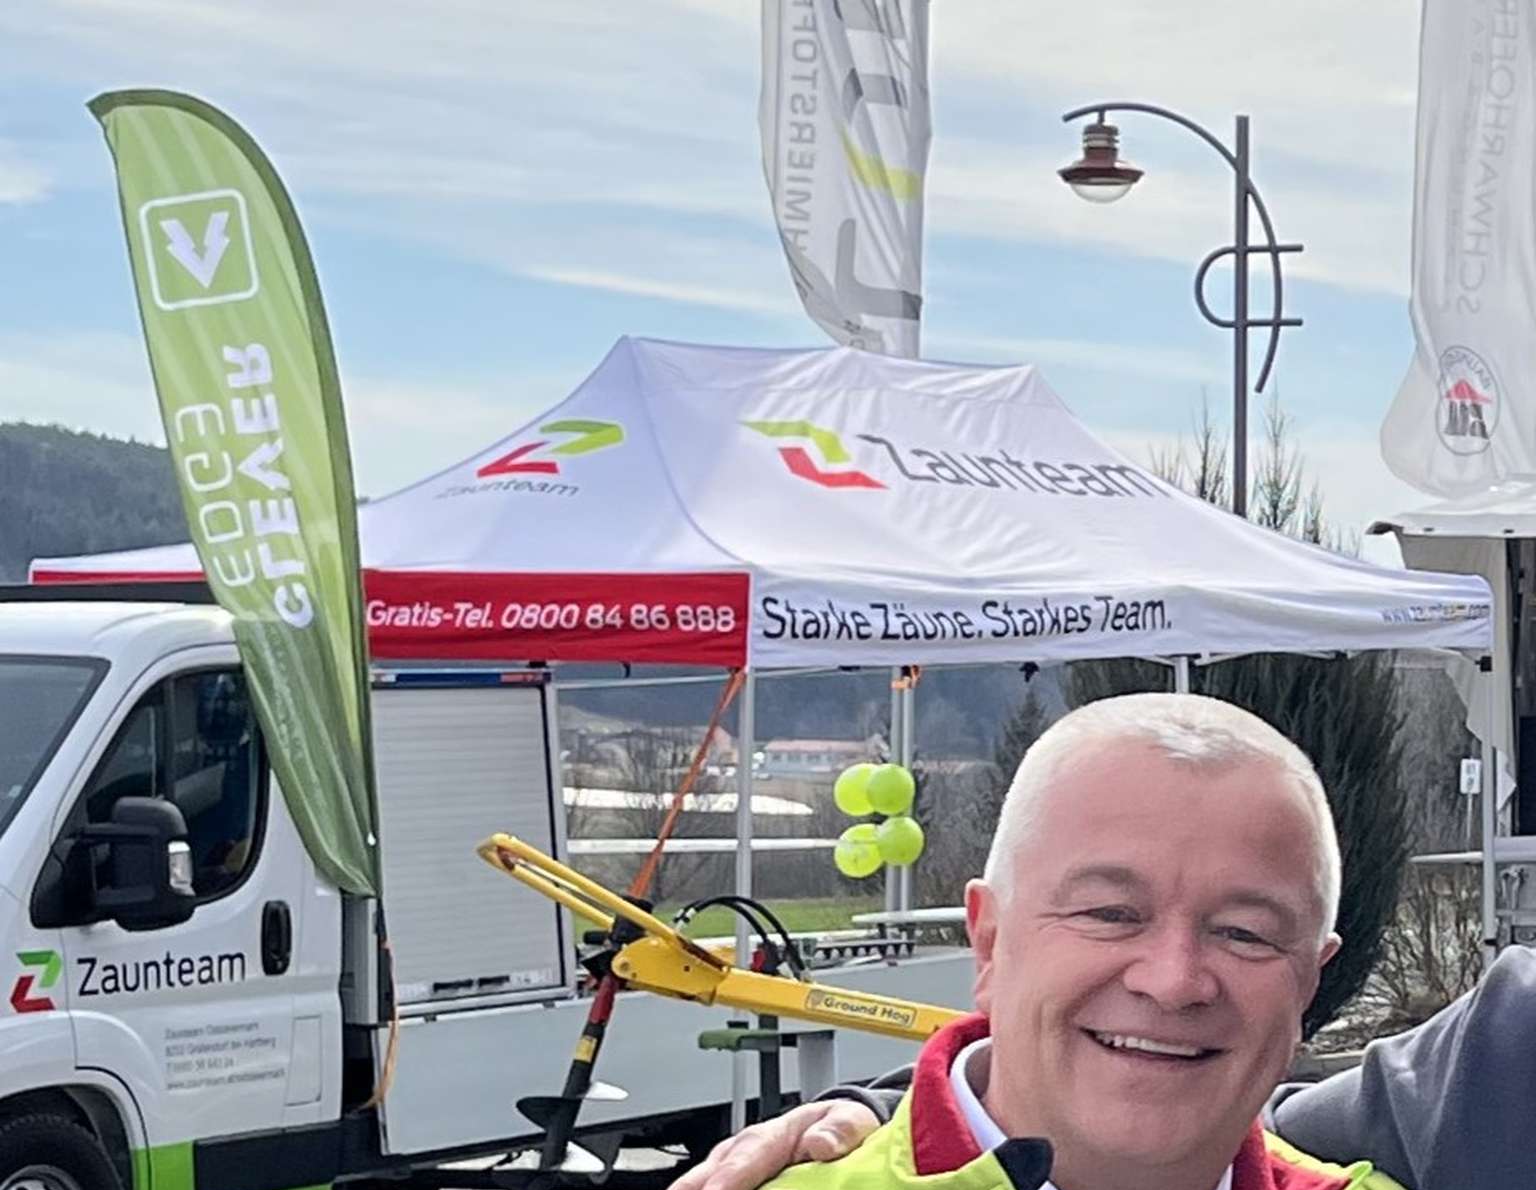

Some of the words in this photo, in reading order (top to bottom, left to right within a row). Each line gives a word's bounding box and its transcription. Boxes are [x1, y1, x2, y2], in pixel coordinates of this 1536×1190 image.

[856, 434, 1172, 498] Zaunteam
[366, 600, 494, 628] Gratis-Tel.
[501, 603, 578, 630] 0800
[585, 604, 622, 630] 84
[630, 604, 670, 631] 86
[676, 605, 735, 633] 888
[762, 597, 873, 640] Starke
[871, 604, 983, 641] Zäune.
[982, 601, 1092, 638] Starkes
[1094, 596, 1171, 632] Team.
[77, 951, 246, 997] Zaunteam
[823, 997, 878, 1016] Ground
[881, 1007, 911, 1024] Hog
